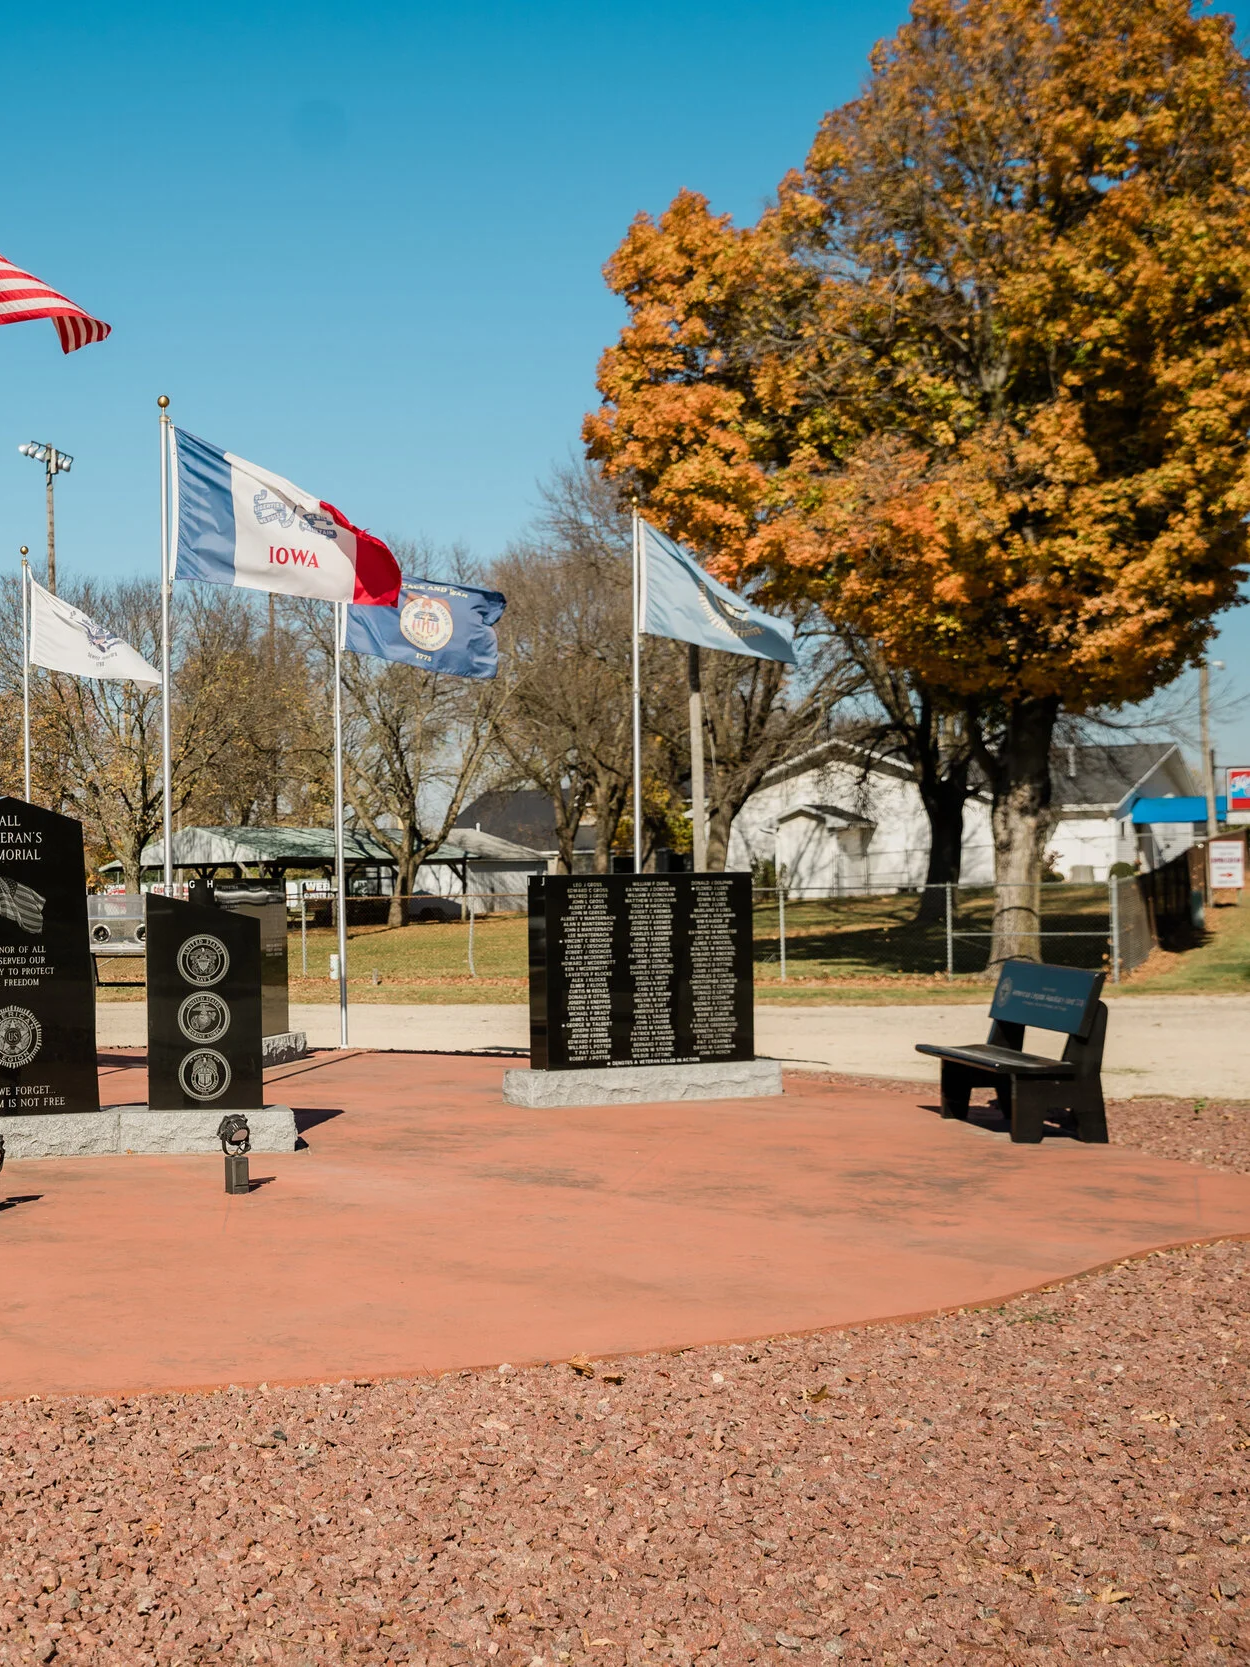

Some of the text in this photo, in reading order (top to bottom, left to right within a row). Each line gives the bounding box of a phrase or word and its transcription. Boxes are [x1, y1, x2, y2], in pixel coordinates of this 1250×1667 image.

[268, 545, 320, 568] IOWA
[427, 586, 447, 594] AND
[0, 815, 21, 826] ALL
[189, 880, 195, 889] G
[206, 880, 214, 888] H
[183, 939, 223, 955] UNITED STATES
[22, 967, 54, 975] PROTECT
[8, 1032, 18, 1041] US
[16, 1085, 55, 1095] FORGET...
[9, 1099, 16, 1107] IS
[21, 1098, 39, 1107] NOT
[44, 1097, 65, 1106] FREE
